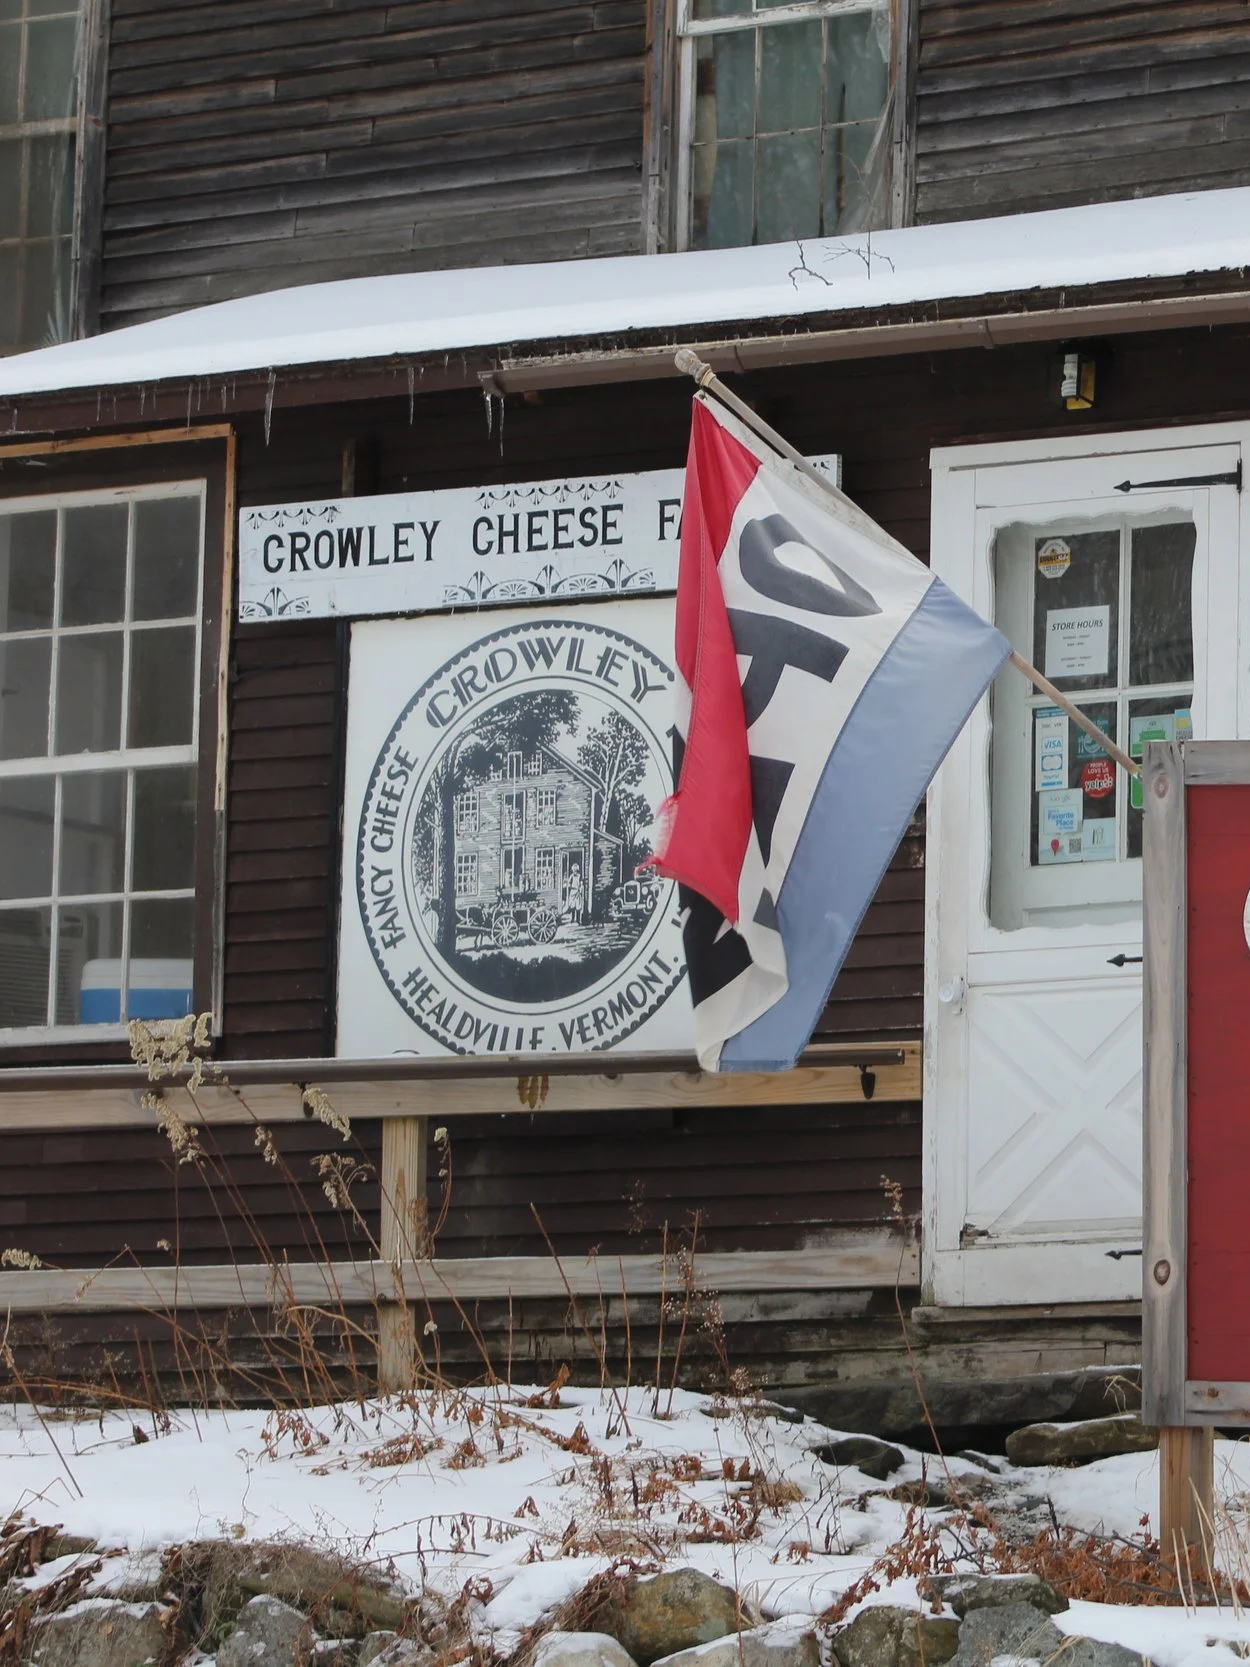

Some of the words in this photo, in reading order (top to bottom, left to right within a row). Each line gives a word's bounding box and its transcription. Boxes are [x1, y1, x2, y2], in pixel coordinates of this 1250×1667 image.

[262, 519, 442, 575] CROWLEY
[471, 502, 625, 557] CHEESE
[1052, 621, 1075, 631] STORE
[1077, 619, 1103, 629] HOURS
[426, 636, 667, 728] CROWLEY
[1043, 740, 1062, 749] VISA
[371, 745, 419, 855] CHEESE
[371, 864, 407, 951] FANCY
